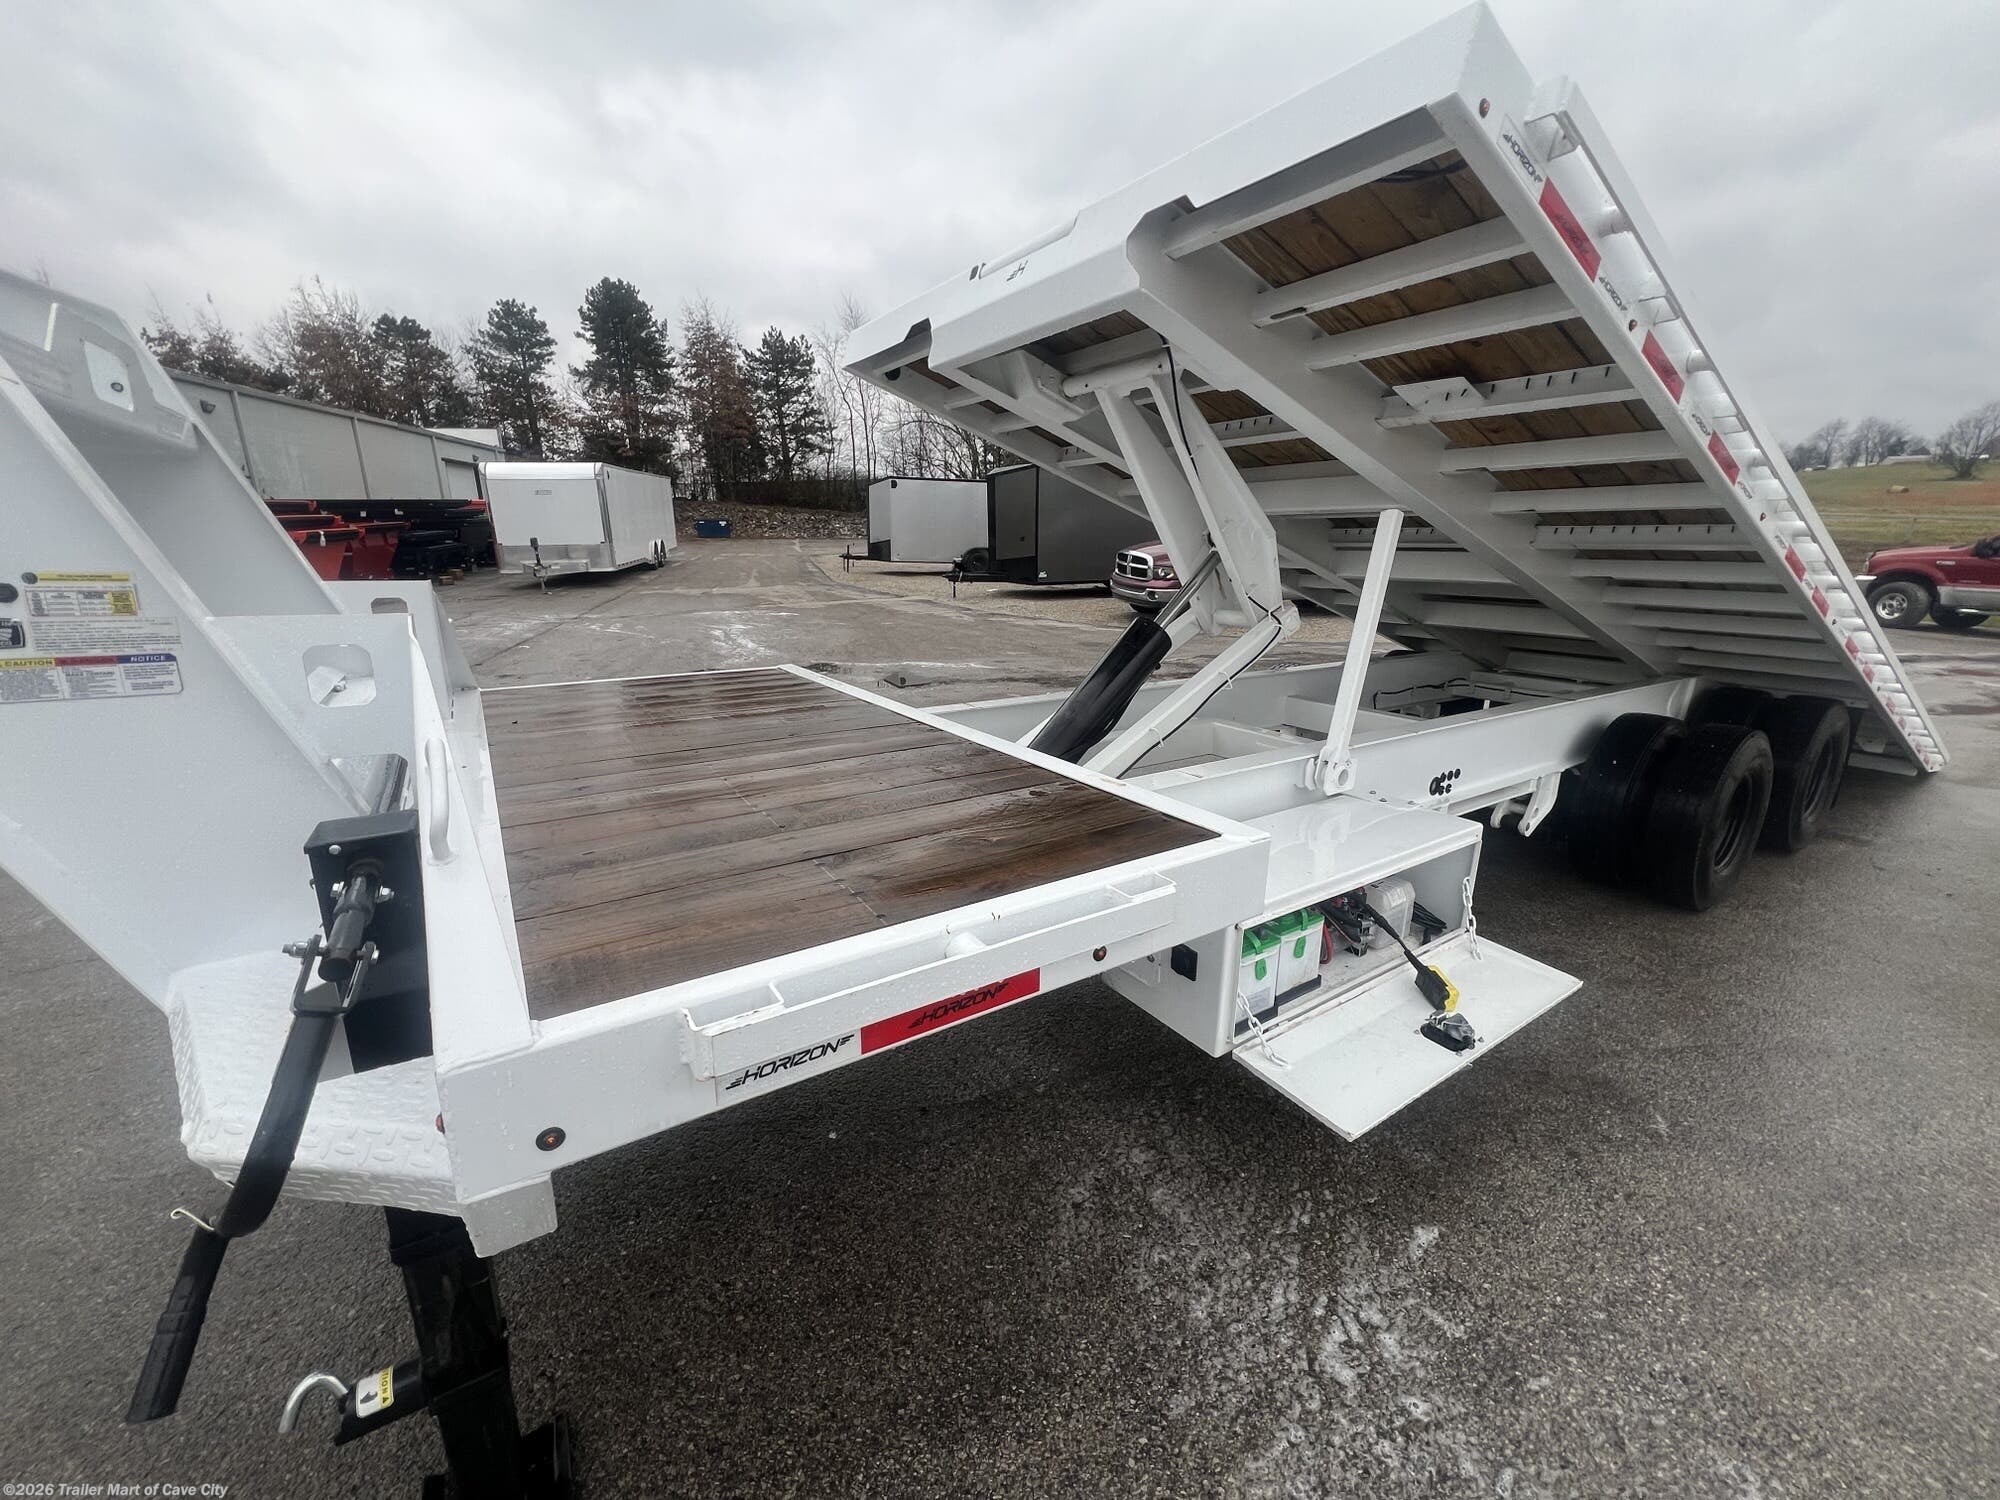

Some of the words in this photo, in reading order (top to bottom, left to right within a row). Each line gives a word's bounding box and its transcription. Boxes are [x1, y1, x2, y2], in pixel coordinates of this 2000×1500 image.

[1508, 134, 1540, 182] HORIZON
[918, 984, 1001, 1024] HORIZON
[739, 1039, 843, 1086] HORIZON
